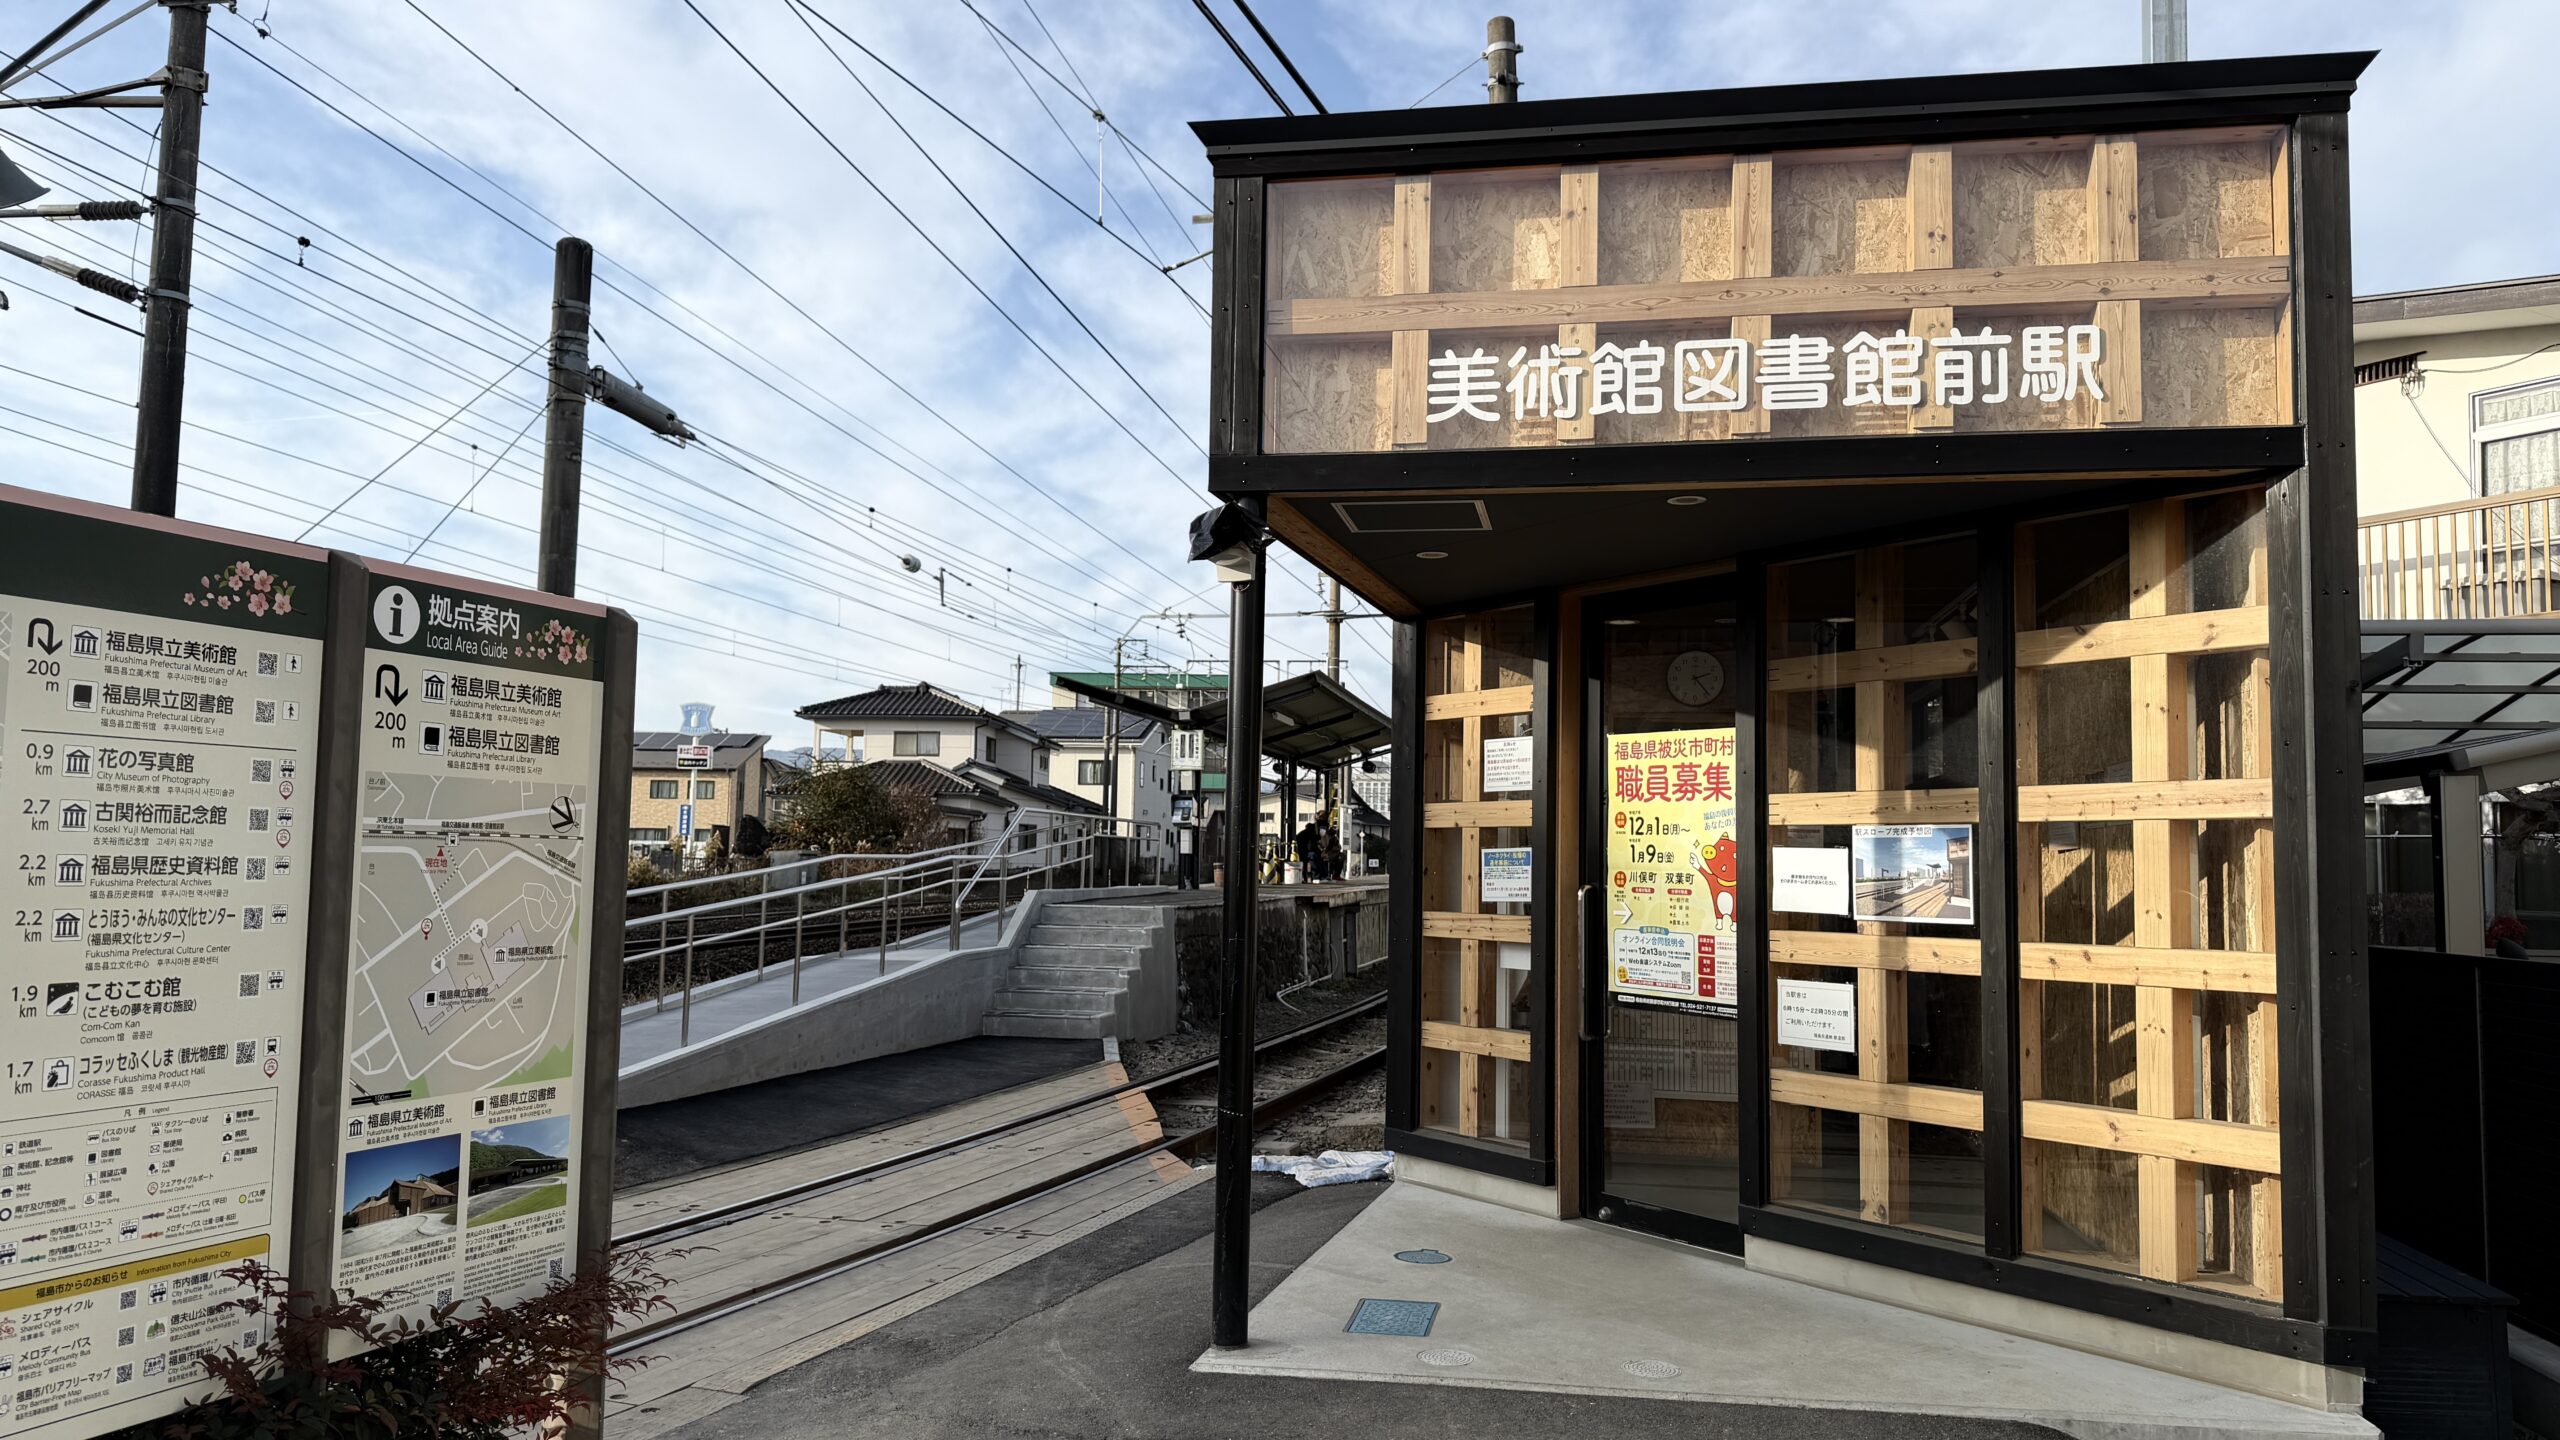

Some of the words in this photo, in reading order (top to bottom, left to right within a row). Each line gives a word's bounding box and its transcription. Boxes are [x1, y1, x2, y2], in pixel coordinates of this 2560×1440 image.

[1424, 323, 2105, 424] 美術館図書館前駅
[428, 594, 520, 640] 拠点案内
[106, 630, 237, 665] 福島県立美術館
[426, 632, 452, 651] Local
[455, 637, 477, 655] Area
[480, 640, 508, 659] Guide
[27, 659, 60, 676] 200
[105, 654, 148, 666] Fukushima
[150, 659, 191, 671] Prefectural
[193, 664, 225, 675] Museum
[227, 668, 234, 676] of
[236, 669, 247, 678] Art
[46, 681, 59, 692] m
[451, 674, 562, 708] 福島県立美術館
[102, 683, 234, 715] 福島県立図書館
[101, 707, 144, 718] Fukushima
[147, 711, 188, 722] Prefectural
[190, 715, 215, 725] Library
[450, 698, 483, 710] Fukushima
[485, 702, 517, 713] Prefectural
[519, 706, 544, 716] Museum
[545, 709, 550, 717] of
[551, 709, 561, 718] Art
[375, 711, 406, 730] 200
[392, 736, 405, 748] m
[449, 726, 560, 755] 福島県立図書館
[1615, 736, 1735, 760] 福島県被災市町村
[26, 743, 54, 760] 0.9
[448, 750, 481, 760] Fukushima
[482, 752, 515, 762] Prefectural
[516, 755, 536, 764] Library
[35, 761, 52, 776] km
[98, 748, 194, 773] 花の写真館
[97, 771, 113, 781] City
[115, 773, 150, 782] Museum
[152, 774, 160, 782] of
[162, 775, 211, 785] Photography
[1615, 762, 1732, 803] 職員募集
[23, 799, 50, 815] 2.7
[95, 803, 227, 825] 古関裕而記念館
[31, 818, 49, 831] km
[93, 825, 121, 834] Koseki
[123, 825, 139, 836] Yuji
[141, 826, 177, 835] Memorial
[180, 827, 195, 835] Hall
[1629, 817, 1690, 836] 12月1日(月)～
[1855, 827, 1932, 837] 駅スロープ完成予想図
[19, 854, 46, 870] 2.2
[1630, 844, 1674, 863] 1月9日(金)
[91, 855, 239, 876] 福島県歴史資料館
[426, 858, 447, 867] 現在地
[28, 873, 45, 886] km
[90, 879, 134, 887] Fukushima
[136, 878, 178, 887] Prefectural
[180, 878, 212, 886] Archives
[1629, 872, 1657, 883] 川俣町
[1665, 873, 1694, 885] 双葉町
[15, 910, 43, 926] 2.2
[88, 907, 235, 929] とうほう・みんなの文化センター
[24, 929, 42, 942] km
[1622, 935, 1685, 948] オンライン合同説明会
[86, 950, 130, 958] Fukushima
[132, 948, 174, 957] Prefectural
[177, 946, 204, 955] Culture
[206, 945, 231, 954] Center
[508, 946, 553, 956] 福島県立美術館
[12, 985, 38, 1002] 1.9
[85, 977, 181, 1001] こむこむ館
[439, 988, 488, 1000] 福島県立図書館
[19, 1005, 37, 1018] km
[81, 1021, 122, 1032] Com-Com
[125, 1020, 140, 1029] Kan
[1785, 1018, 1835, 1029] ご利用いただけます。
[80, 1034, 115, 1045] Comcom
[7, 1061, 34, 1078] 1.7
[80, 1047, 174, 1075] コラッセふくしま
[78, 1076, 111, 1088] Corasse
[114, 1072, 156, 1086] Fukushima
[159, 1069, 189, 1080] Product
[191, 1067, 206, 1076] Hall
[14, 1081, 32, 1095] km
[77, 1089, 116, 1100] CORASSE
[489, 1087, 556, 1109] 福島県立図書館
[367, 1104, 445, 1129] 福島県立美術館
[512, 1105, 533, 1113] Prefectural
[165, 1115, 208, 1127] タクシーのりば
[366, 1127, 392, 1136] Fukushima
[393, 1123, 418, 1132] Prefectural
[419, 1120, 438, 1128] Museum
[102, 1125, 136, 1136] バスのりば
[137, 1261, 171, 1275] Information
[172, 1258, 187, 1268] from
[188, 1254, 219, 1265] Fukushima
[36, 1270, 128, 1299] 福島市からのお知らせ
[184, 1287, 203, 1295] Shuttle
[22, 1299, 94, 1324] シェアサイクル
[207, 1316, 219, 1324] Park
[20, 1323, 42, 1333] Shared
[44, 1319, 62, 1327] Cycle
[19, 1337, 91, 1363] メロディーバス
[18, 1363, 42, 1372] Melody
[44, 1353, 78, 1365] Community
[16, 1367, 111, 1403] 福島市バリアフリーマップ
